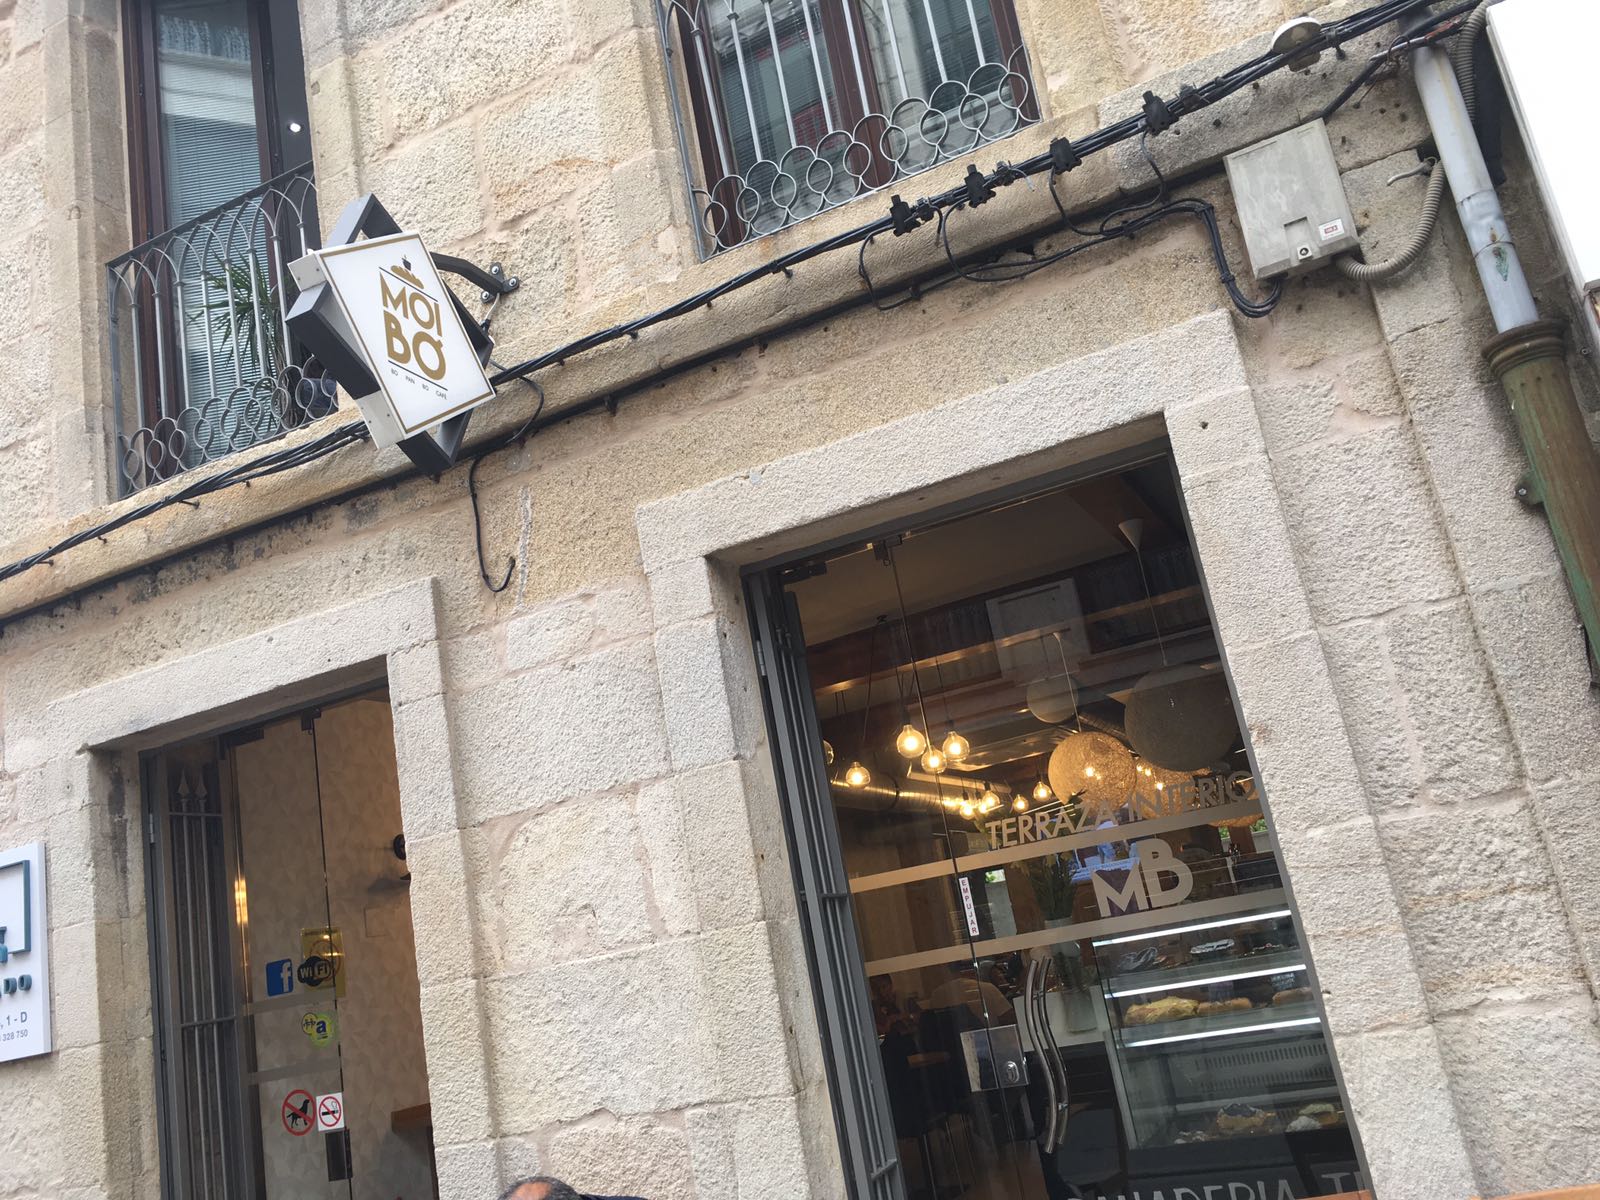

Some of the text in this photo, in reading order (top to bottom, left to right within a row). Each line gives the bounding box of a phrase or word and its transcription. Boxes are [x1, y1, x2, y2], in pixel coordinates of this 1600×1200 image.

[379, 270, 443, 337] MOI
[984, 801, 1120, 850] TERRAZA
[961, 879, 978, 934] EMPUJAR
[1092, 838, 1194, 918] MB
